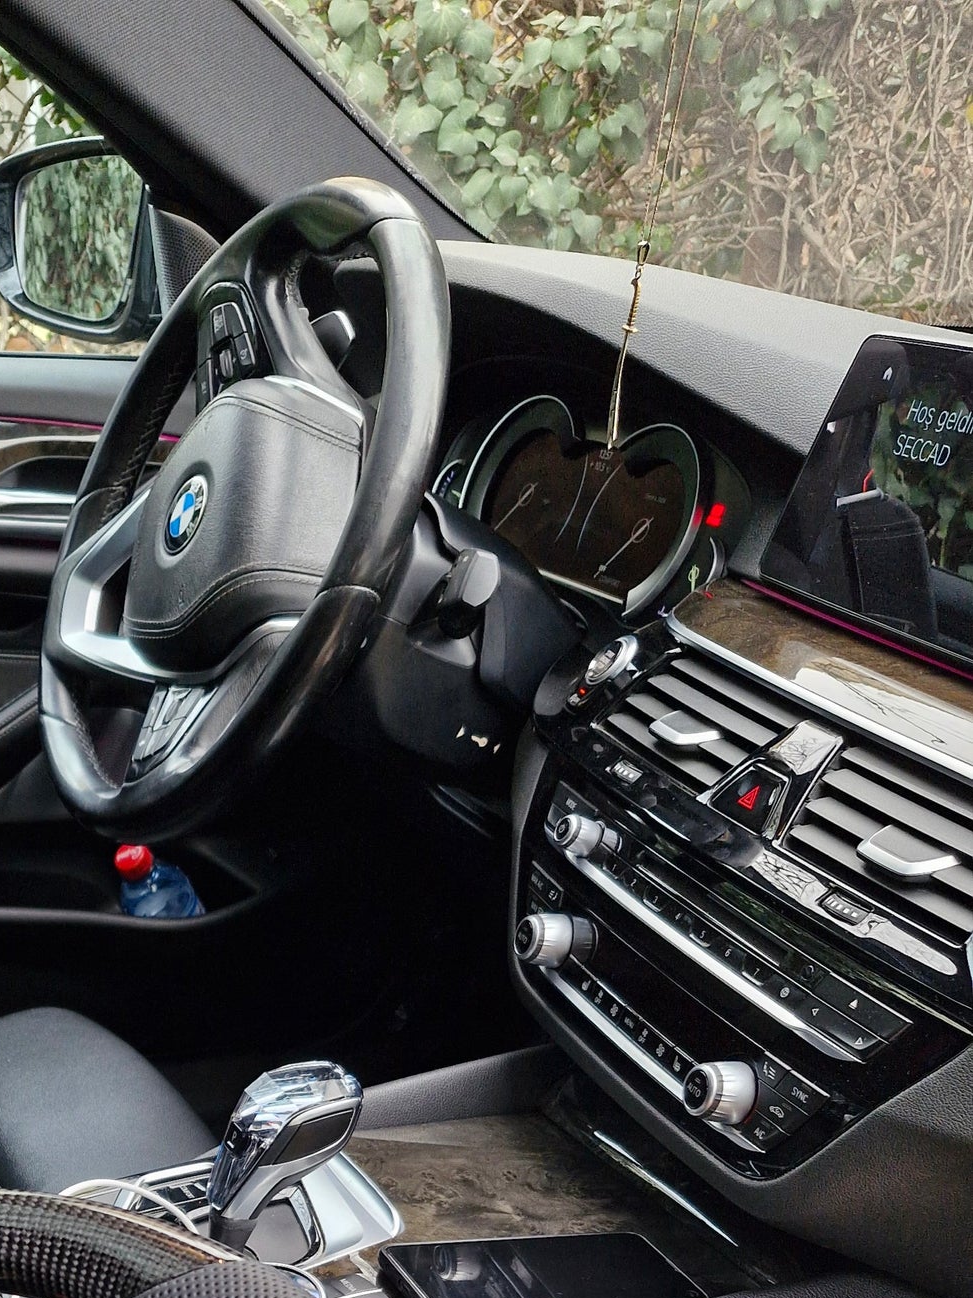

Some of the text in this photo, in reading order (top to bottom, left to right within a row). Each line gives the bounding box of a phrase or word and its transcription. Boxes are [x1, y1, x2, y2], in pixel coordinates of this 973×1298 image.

[907, 399, 936, 431] Hoş
[893, 434, 951, 467] SECCAD
[630, 878, 637, 887] 2
[652, 895, 659, 904] 3
[699, 930, 706, 939] 5
[724, 948, 732, 957] 6
[687, 1081, 702, 1098] AUTO
[791, 1086, 809, 1104] SYNC
[753, 1126, 766, 1140] A/C
